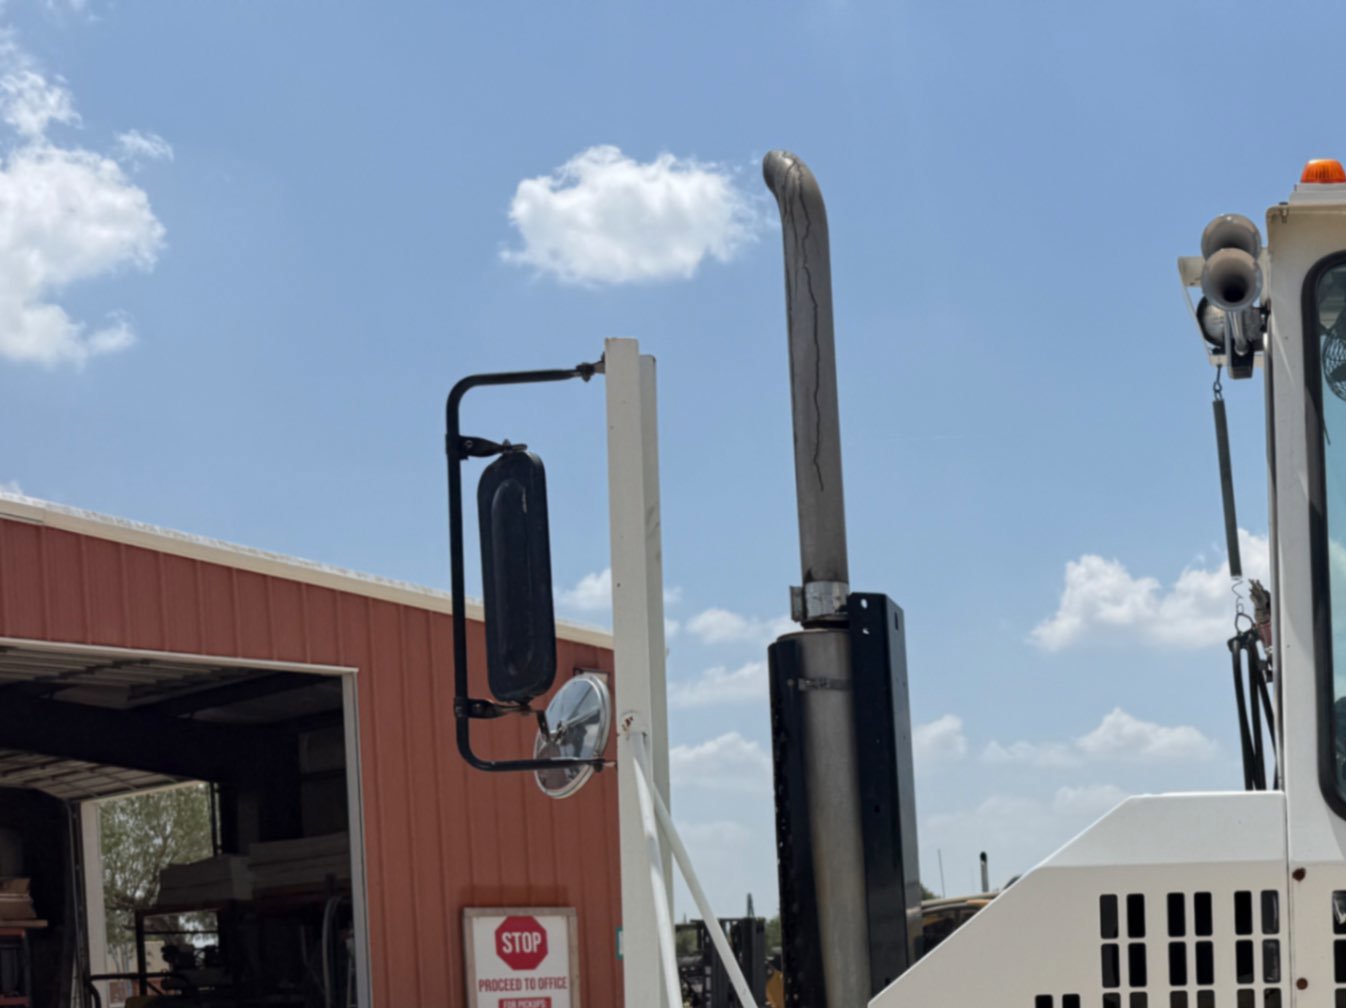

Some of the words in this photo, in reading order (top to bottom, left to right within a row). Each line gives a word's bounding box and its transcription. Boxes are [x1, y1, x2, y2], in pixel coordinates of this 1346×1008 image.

[501, 931, 542, 954] STOP
[478, 978, 522, 992] PROCEED
[524, 977, 536, 991] TO
[538, 976, 568, 990] OFFICE
